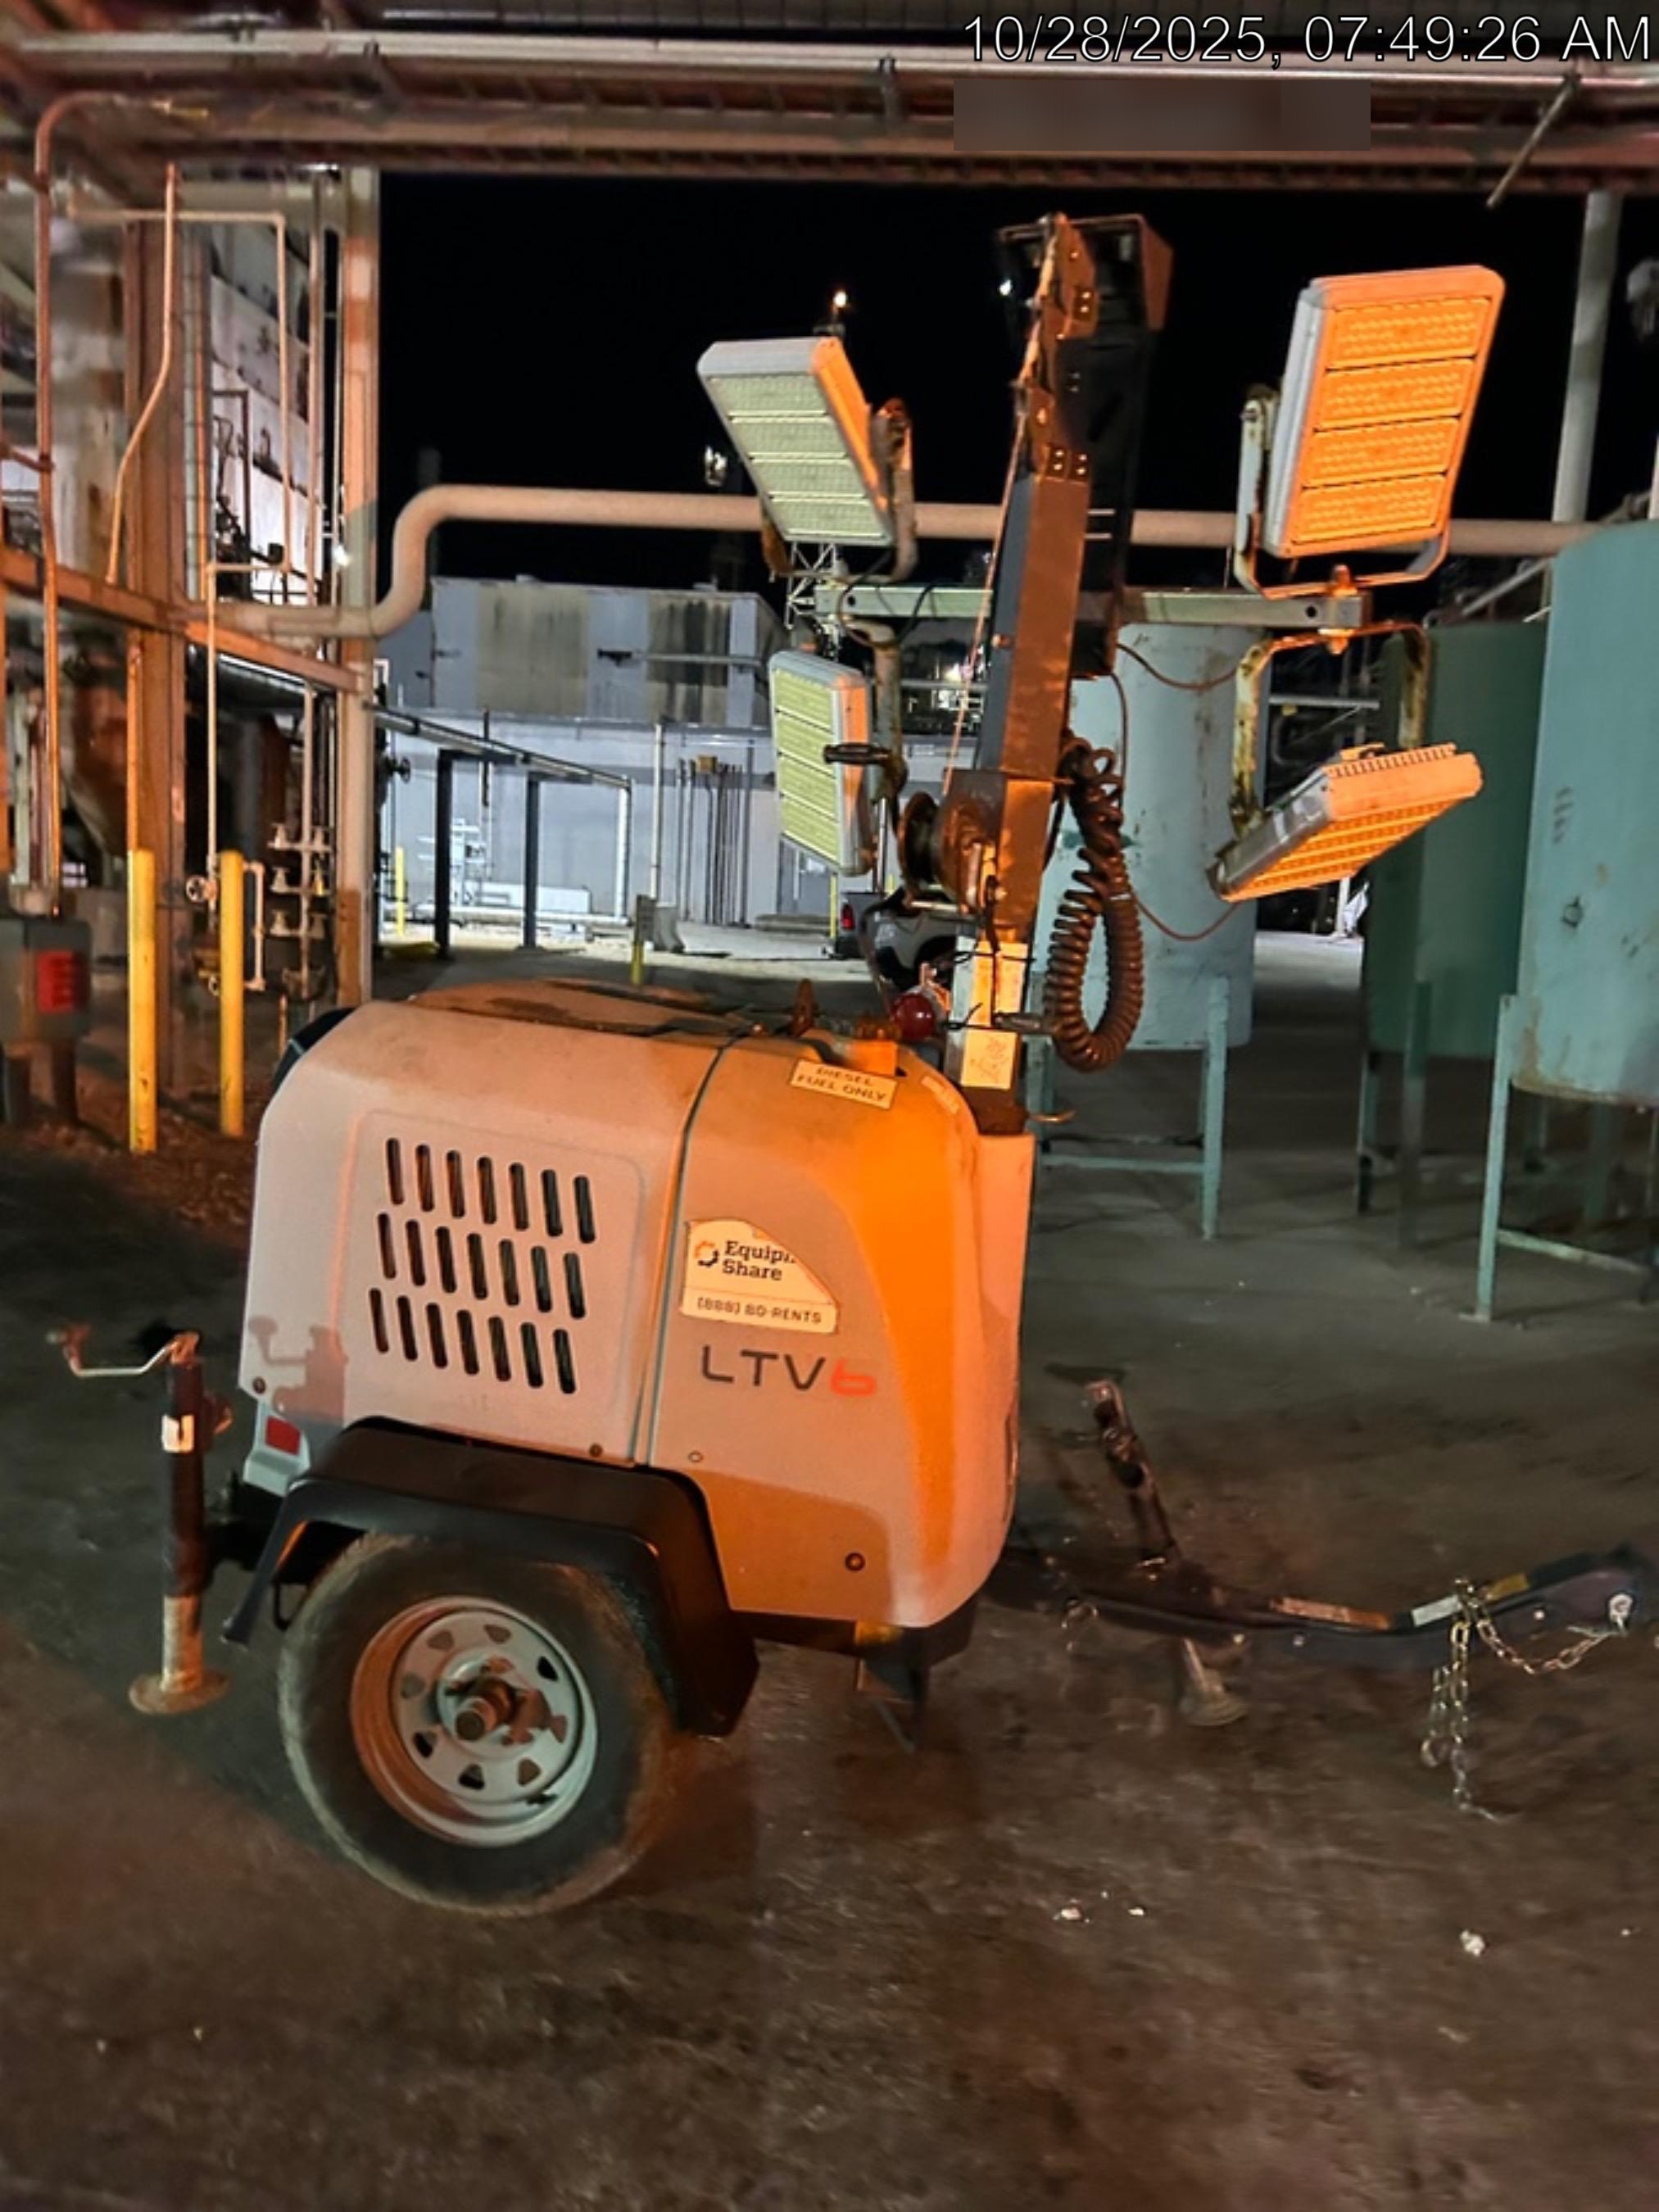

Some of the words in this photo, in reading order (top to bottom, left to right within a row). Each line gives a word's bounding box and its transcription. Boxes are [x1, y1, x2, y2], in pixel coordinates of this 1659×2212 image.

[797, 1074, 835, 1090] FUEL
[842, 1084, 886, 1101] ONLY
[817, 1067, 872, 1086] DIESEL
[722, 1258, 783, 1281] Share
[701, 1344, 876, 1397] LTV6
